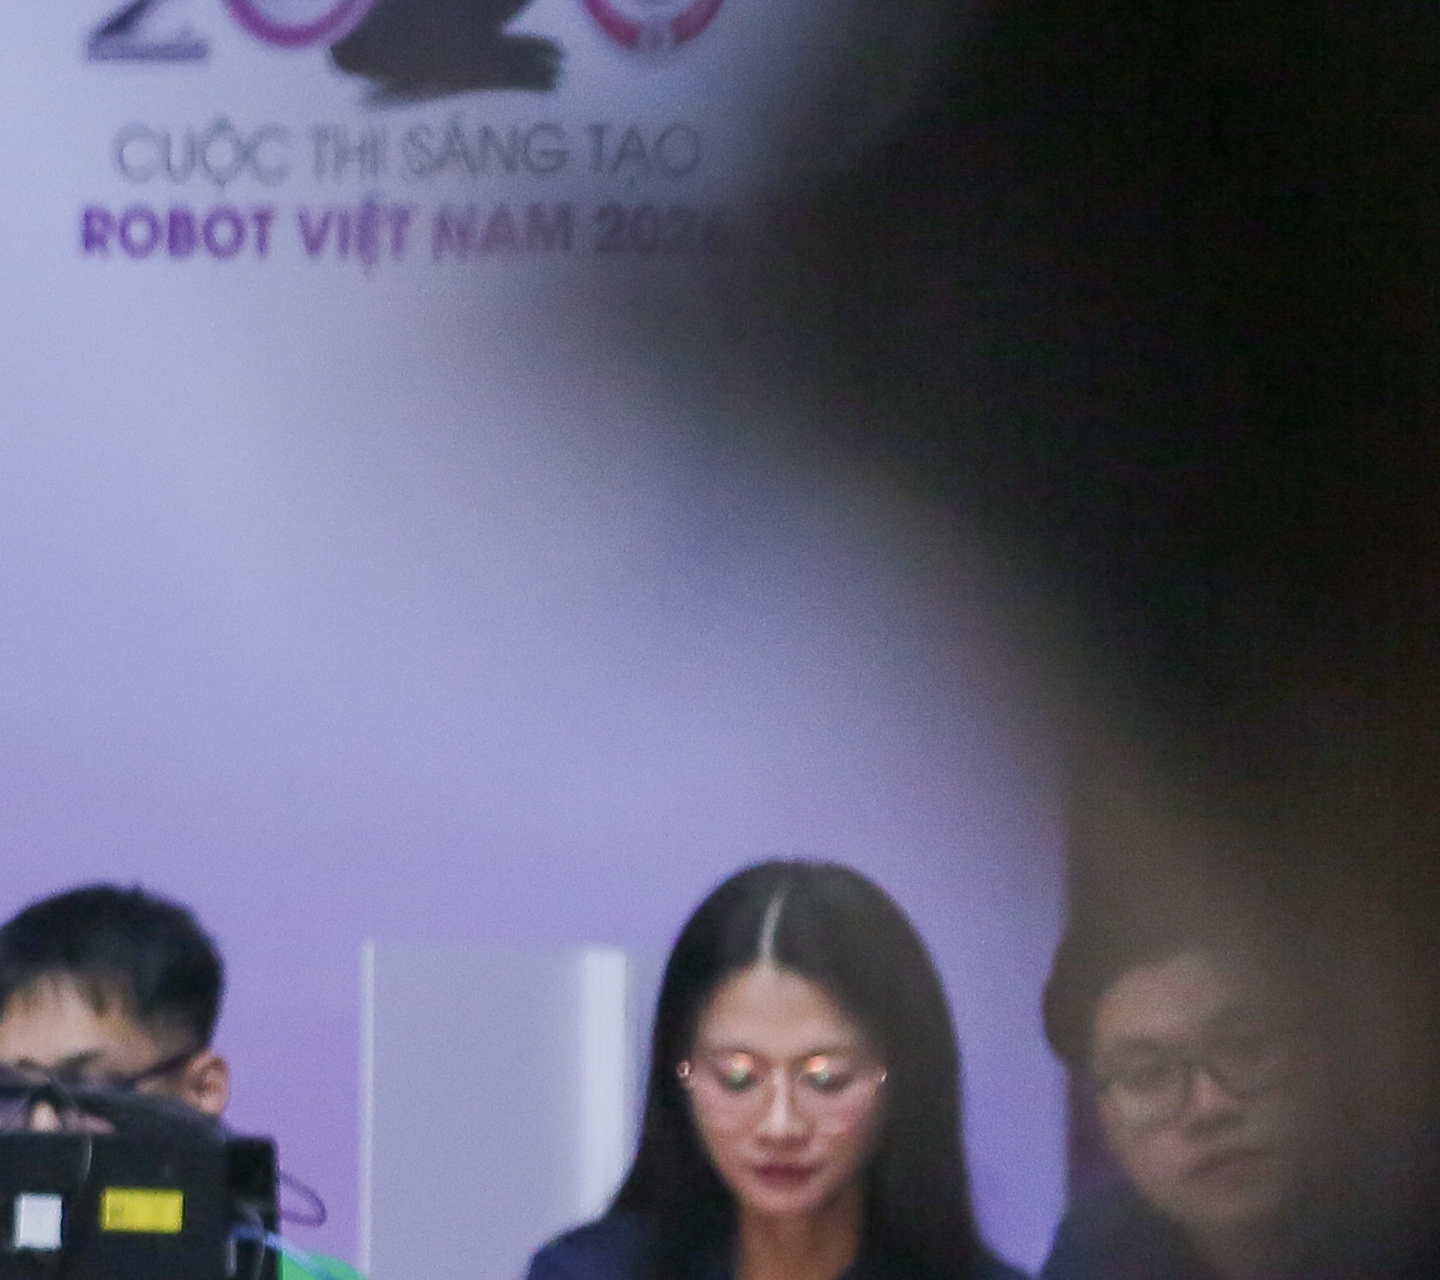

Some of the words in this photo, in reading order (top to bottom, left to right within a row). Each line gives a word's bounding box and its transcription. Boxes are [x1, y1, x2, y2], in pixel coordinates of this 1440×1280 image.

[111, 115, 288, 187] CUỘC
[310, 122, 382, 182] THI
[401, 112, 570, 183] SÁNG
[585, 122, 703, 187] TẠO
[79, 202, 275, 261] ROBOT
[296, 192, 413, 276] VIỆT
[432, 200, 575, 261] NAM
